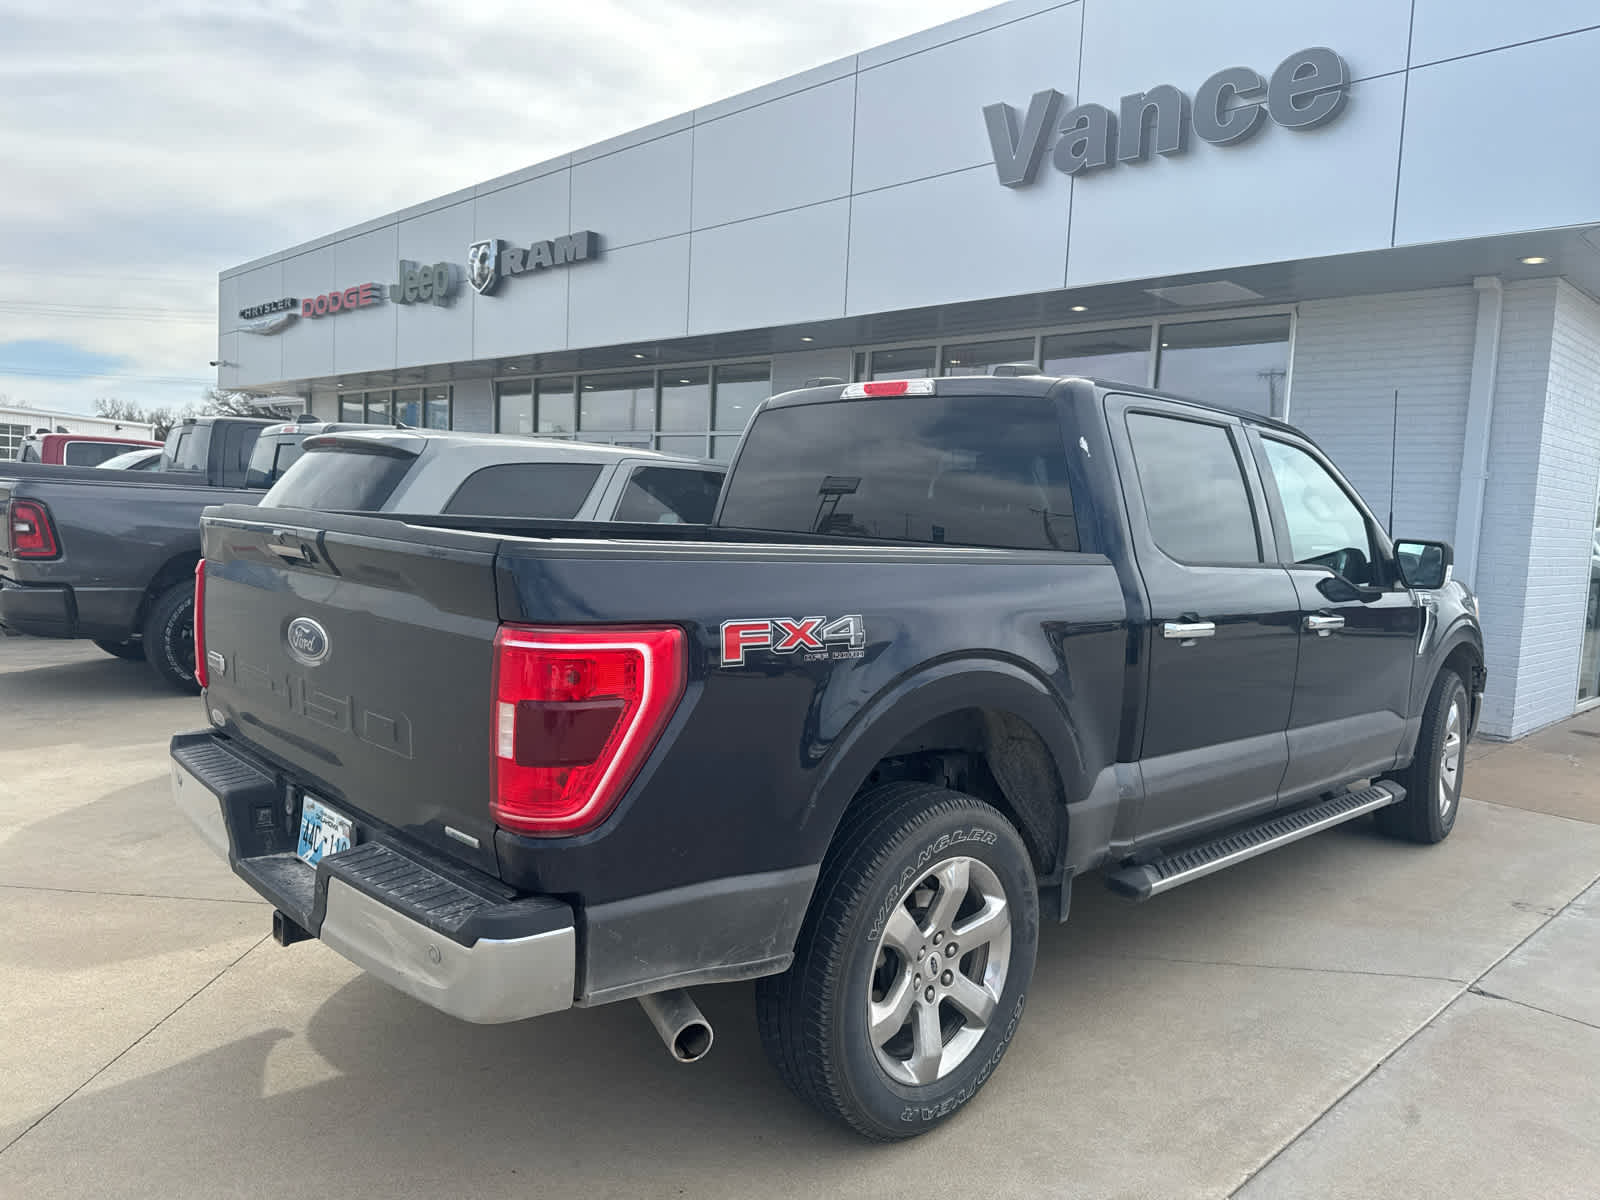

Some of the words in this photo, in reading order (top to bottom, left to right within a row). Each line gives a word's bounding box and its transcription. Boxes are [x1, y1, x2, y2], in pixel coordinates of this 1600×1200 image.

[982, 46, 1350, 188] Vance
[501, 231, 592, 277] RAM
[302, 282, 376, 319] DODGE
[390, 259, 452, 306] Jeep
[720, 615, 865, 667] FX4
[867, 828, 997, 940] WRANGLER
